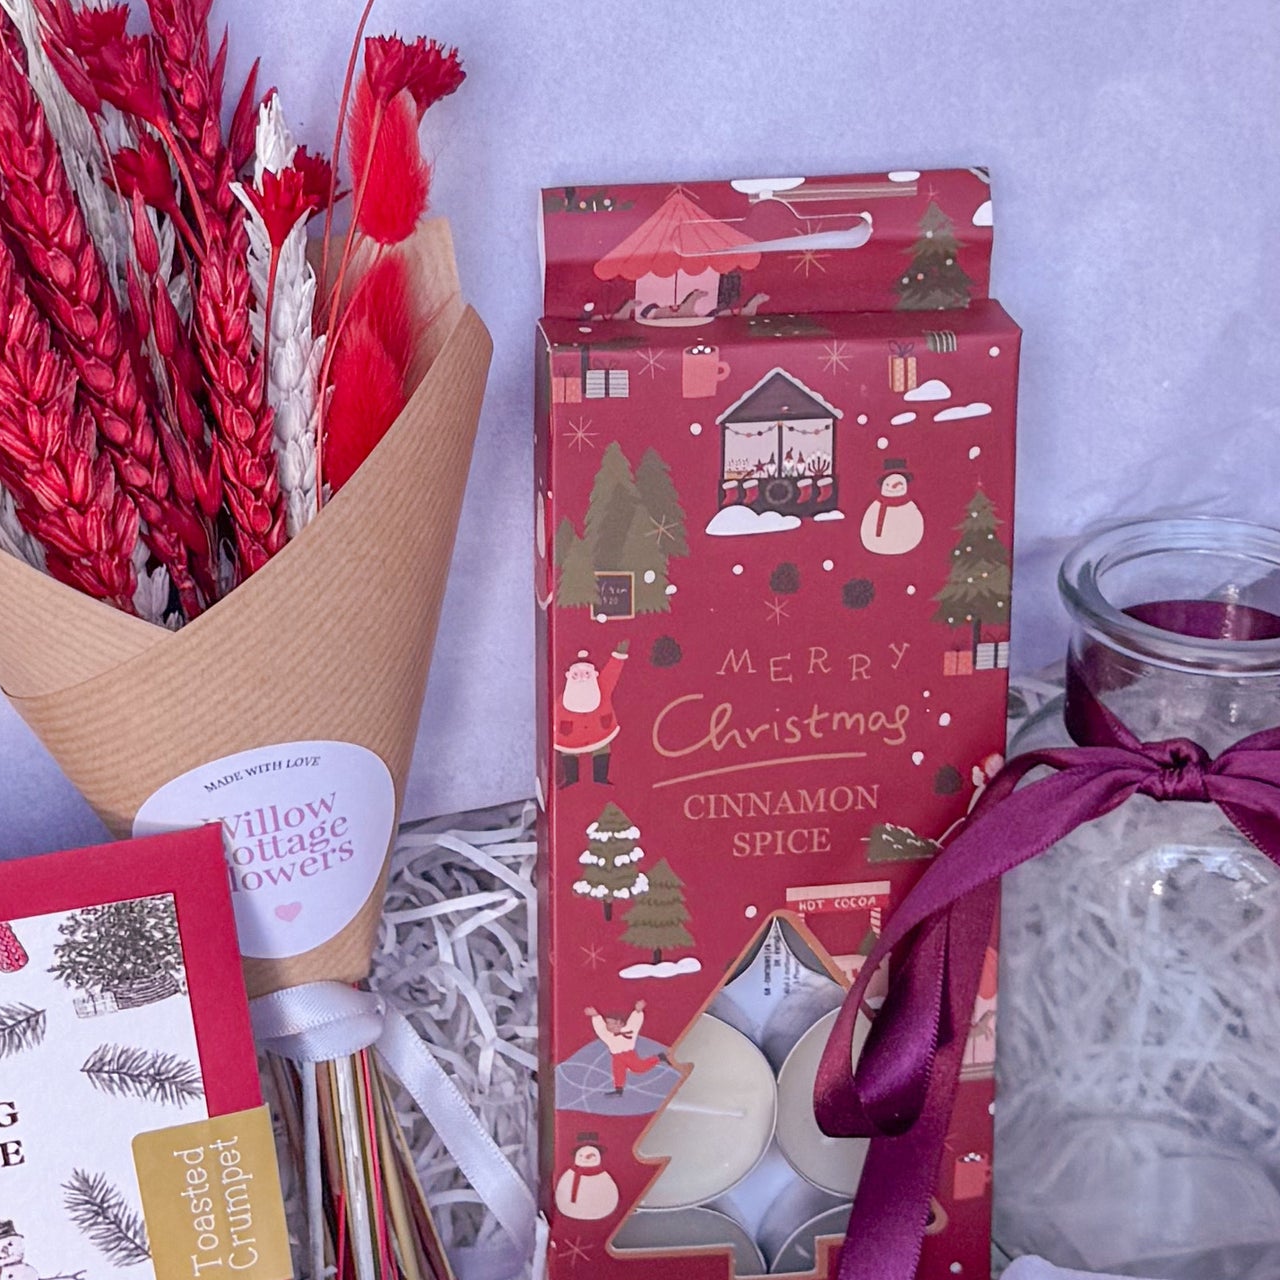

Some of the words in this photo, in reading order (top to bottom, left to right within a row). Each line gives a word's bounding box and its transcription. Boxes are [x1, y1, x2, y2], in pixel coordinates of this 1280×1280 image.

[716, 643, 910, 683] MERRY
[652, 693, 910, 758] Christmas
[203, 771, 244, 793] MADE
[245, 760, 283, 778] WITH
[285, 755, 321, 769] LOVE
[683, 784, 880, 820] CINNAMON
[231, 815, 349, 866] ottage
[732, 827, 832, 858] SPICE
[228, 839, 355, 893] lowers
[798, 899, 825, 911] HOT
[834, 895, 877, 909] COCOA
[173, 1146, 223, 1277] Toasted
[209, 1136, 258, 1270] Crumpet
